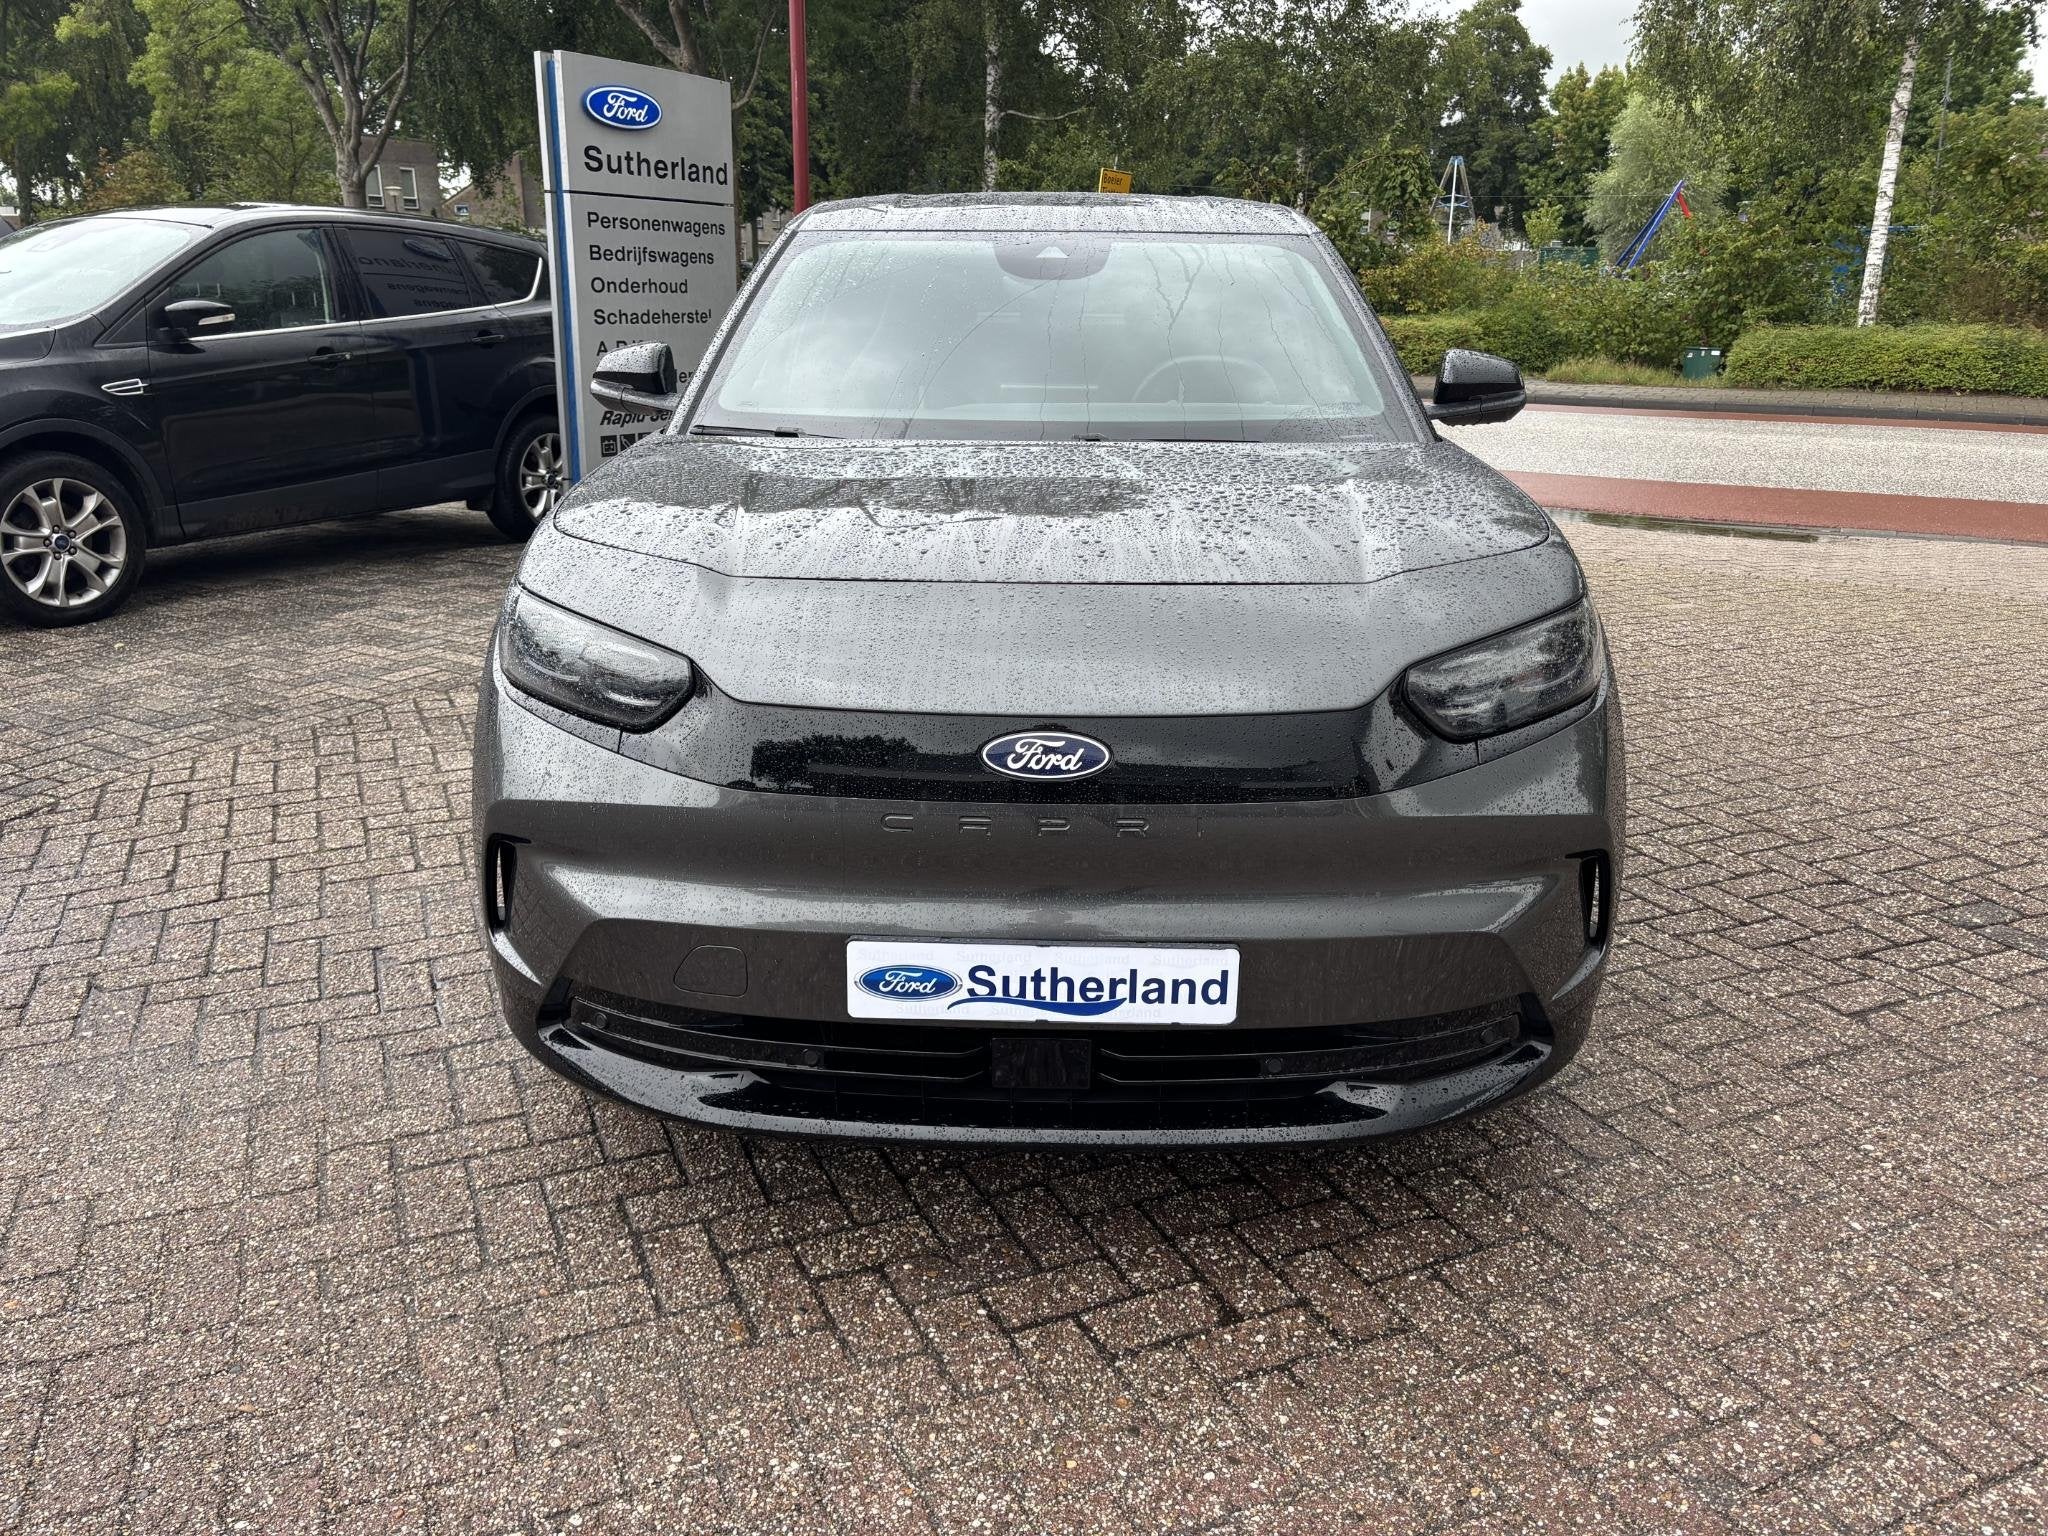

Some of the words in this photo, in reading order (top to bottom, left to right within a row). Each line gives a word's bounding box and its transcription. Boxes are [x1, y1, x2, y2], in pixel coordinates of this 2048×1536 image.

[603, 92, 649, 122] Ford
[584, 145, 728, 185] Sutherland
[587, 211, 725, 237] Personenwagens
[589, 244, 714, 266] Bedrijfswagens
[590, 276, 688, 294] Onderhoud
[1007, 738, 1085, 771] Ford
[880, 813, 1202, 838] CAPRI
[879, 971, 938, 995] Ford
[966, 964, 1229, 1005] Sutherland
